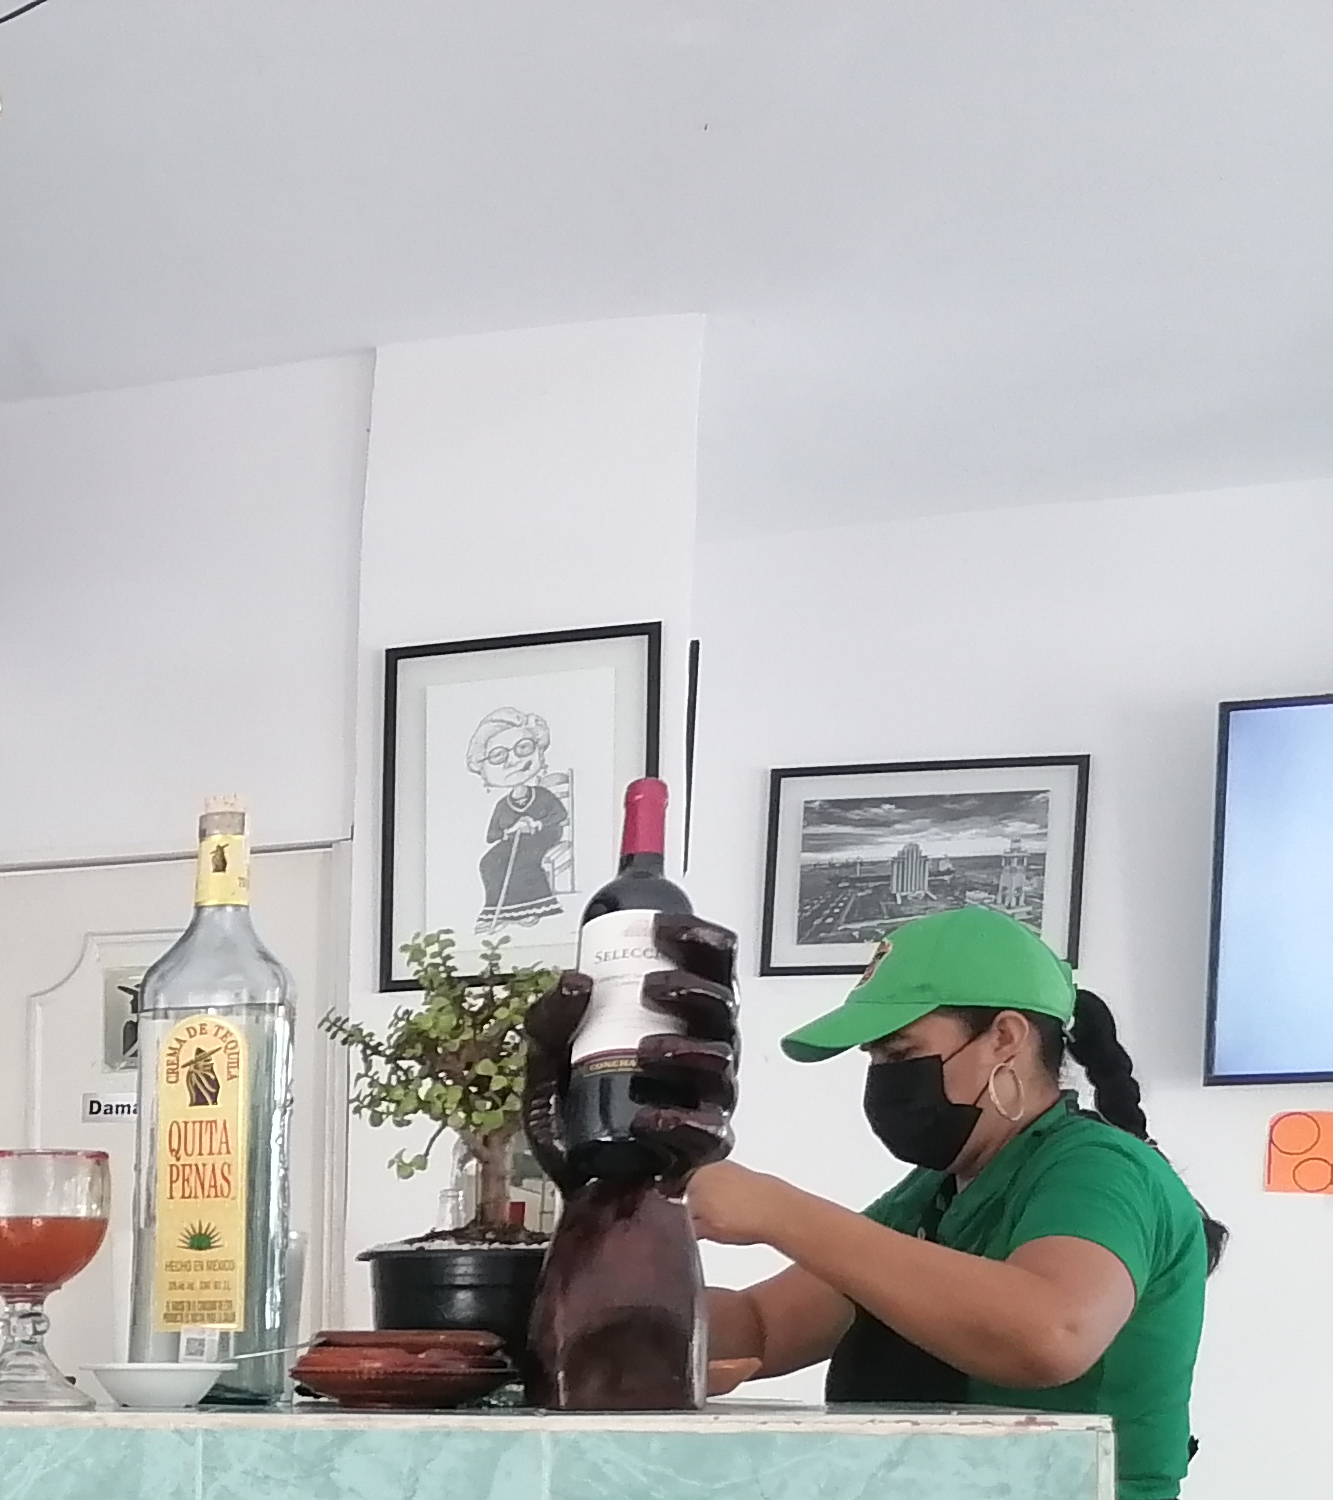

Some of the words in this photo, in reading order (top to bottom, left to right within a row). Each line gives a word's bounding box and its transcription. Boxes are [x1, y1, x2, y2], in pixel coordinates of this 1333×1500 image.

[594, 948, 662, 964] SELECC
[165, 1037, 187, 1085] CREMA
[186, 1022, 209, 1039] DE
[213, 1023, 240, 1082] TEQUILA
[589, 1059, 638, 1070] CONCHA
[168, 1119, 232, 1162] QUITA
[167, 1162, 232, 1201] PENAS
